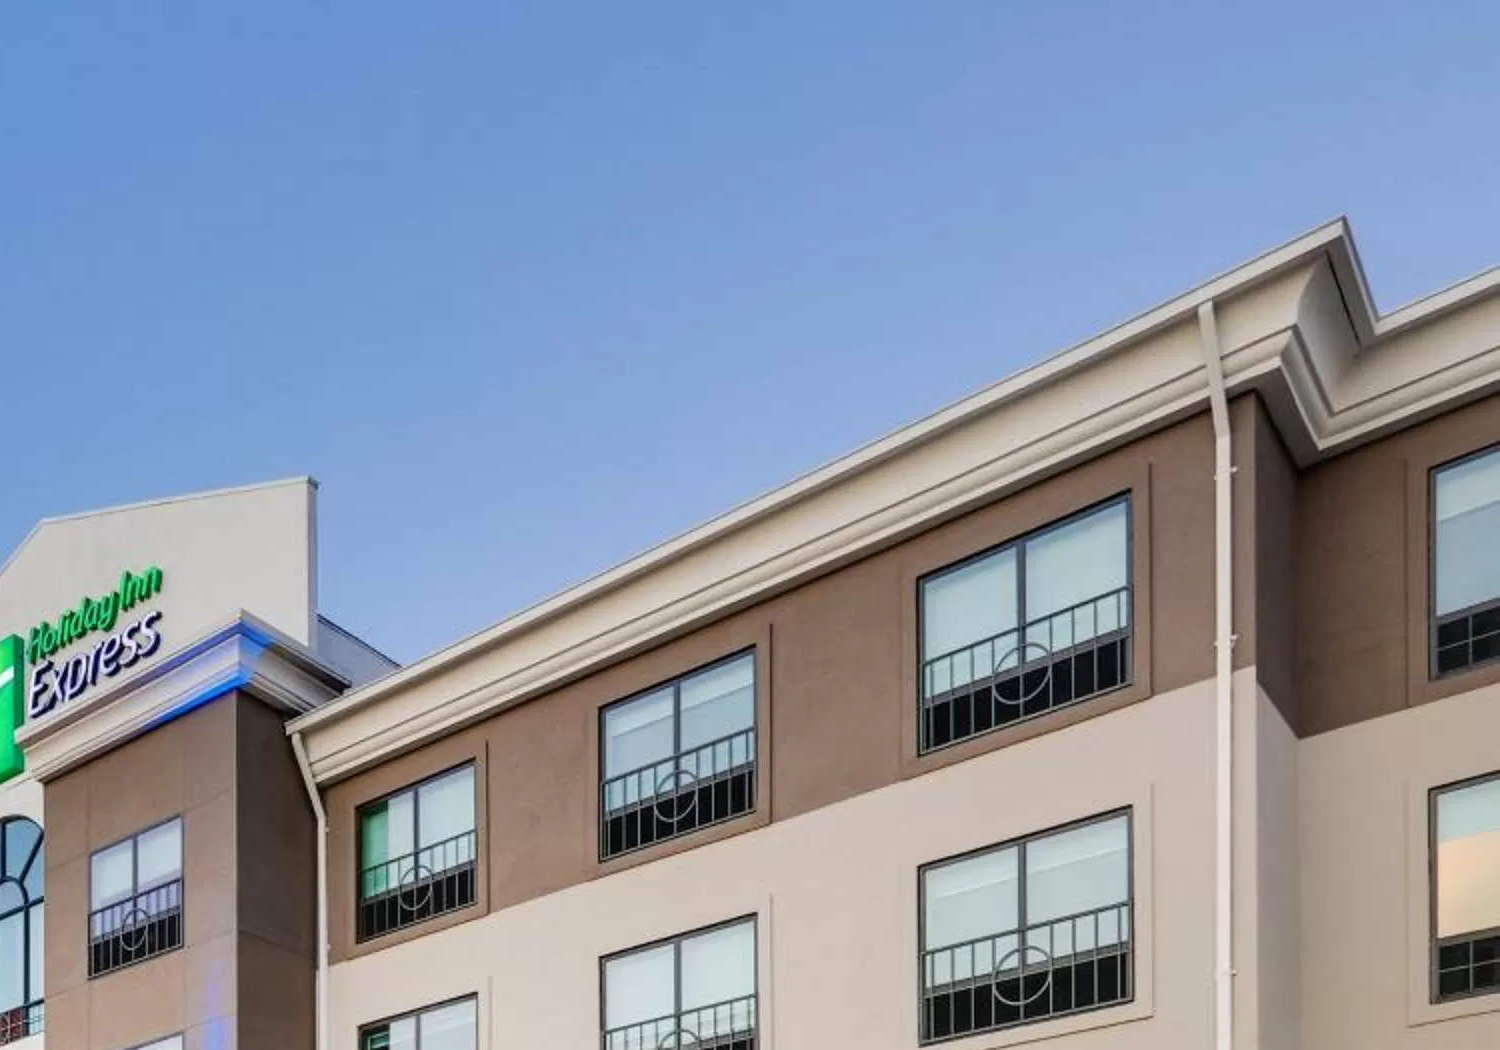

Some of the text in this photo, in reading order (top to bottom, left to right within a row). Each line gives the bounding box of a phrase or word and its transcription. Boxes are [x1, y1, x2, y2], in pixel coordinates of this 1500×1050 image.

[26, 566, 164, 665] Holiday Inn
[28, 610, 163, 719] Express
